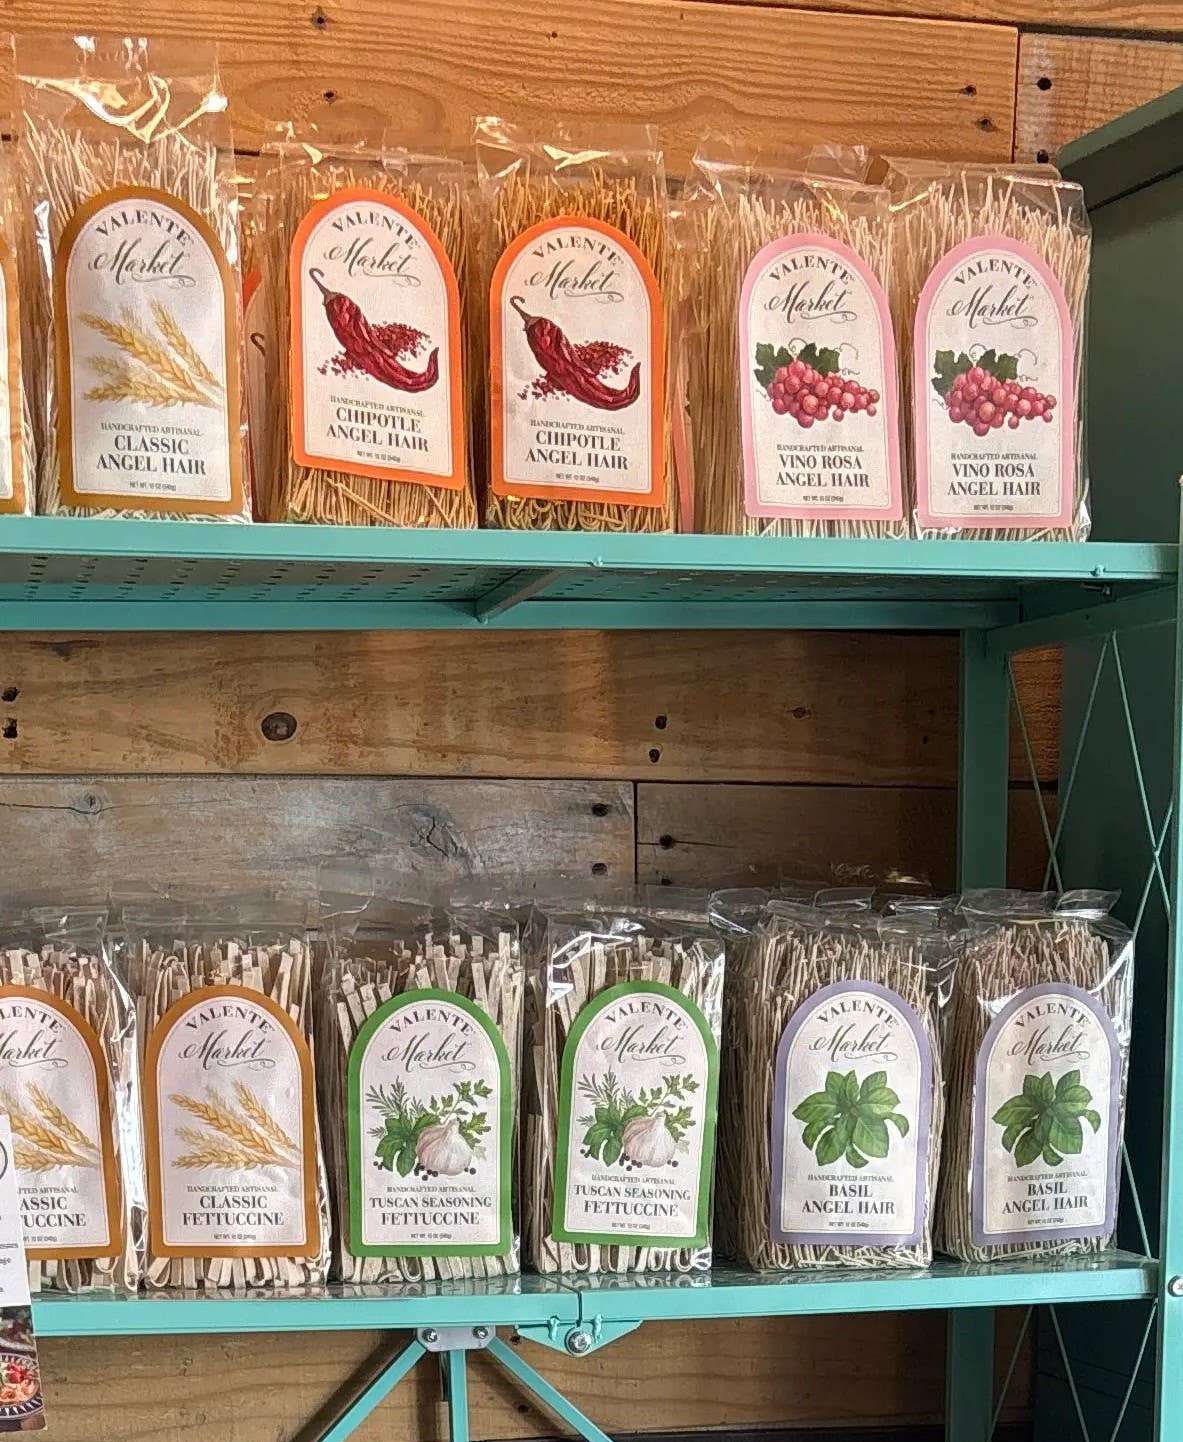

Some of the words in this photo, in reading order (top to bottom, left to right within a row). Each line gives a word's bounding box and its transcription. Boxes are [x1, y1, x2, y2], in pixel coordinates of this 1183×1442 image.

[96, 210, 191, 246] VALENTE
[333, 211, 416, 249] VALENTE
[87, 238, 196, 285] Market
[324, 238, 421, 287] Market
[533, 236, 621, 265] VALENTE
[524, 259, 624, 304] Market
[769, 255, 850, 284] VALENTE
[954, 259, 1036, 289] VALENTE
[764, 280, 857, 324] Market
[946, 284, 1038, 329] Market
[336, 407, 421, 433] CHIPOTLE
[115, 435, 189, 454] CLASSIC
[327, 424, 382, 445] ANGEL
[388, 431, 429, 452] HAIR
[536, 430, 621, 451] CHIPOTLE
[96, 454, 157, 472] ANGEL
[163, 457, 206, 475] HAIR
[525, 448, 582, 465] ANGEL
[588, 452, 628, 470] HAIR
[779, 453, 817, 469] VINO
[822, 454, 862, 469] ROSA
[952, 463, 989, 478] VINO
[995, 463, 1034, 477] ROSA
[776, 472, 827, 487] ANGEL
[831, 473, 870, 487] HAIR
[948, 482, 998, 496] ANGEL
[1003, 482, 1041, 496] HAIR
[0, 1006, 62, 1033] LENTE
[185, 1005, 270, 1034] VALENTE
[389, 1009, 472, 1036] VALENTE
[605, 1001, 685, 1030] VALENTE
[817, 1000, 897, 1028] VALENTE
[1014, 1003, 1089, 1028] VALENTE
[178, 1030, 275, 1071] Market
[382, 1032, 476, 1073] Market
[596, 1023, 686, 1066] Market
[809, 1023, 898, 1063] Market
[1007, 1024, 1090, 1065] Market
[200, 1195, 267, 1209] CLASSIC
[574, 1184, 620, 1197] TUSCAN
[624, 1187, 690, 1200] SEASONING
[830, 1184, 872, 1198] BASIL
[1027, 1182, 1068, 1196] BASIL
[20, 1196, 67, 1211] ASSIC
[369, 1197, 418, 1208] TUSCAN
[422, 1197, 492, 1208] SEASONING
[584, 1200, 678, 1216] FETTUCCINE
[802, 1200, 853, 1214] ANGEL
[859, 1201, 895, 1214] HAIR
[1002, 1199, 1050, 1214] ANGEL
[1054, 1196, 1089, 1210] HAIR
[21, 1213, 86, 1228] UCCINE
[182, 1212, 284, 1226] FETTUCCINE
[382, 1212, 480, 1226] FETTUCCINE
